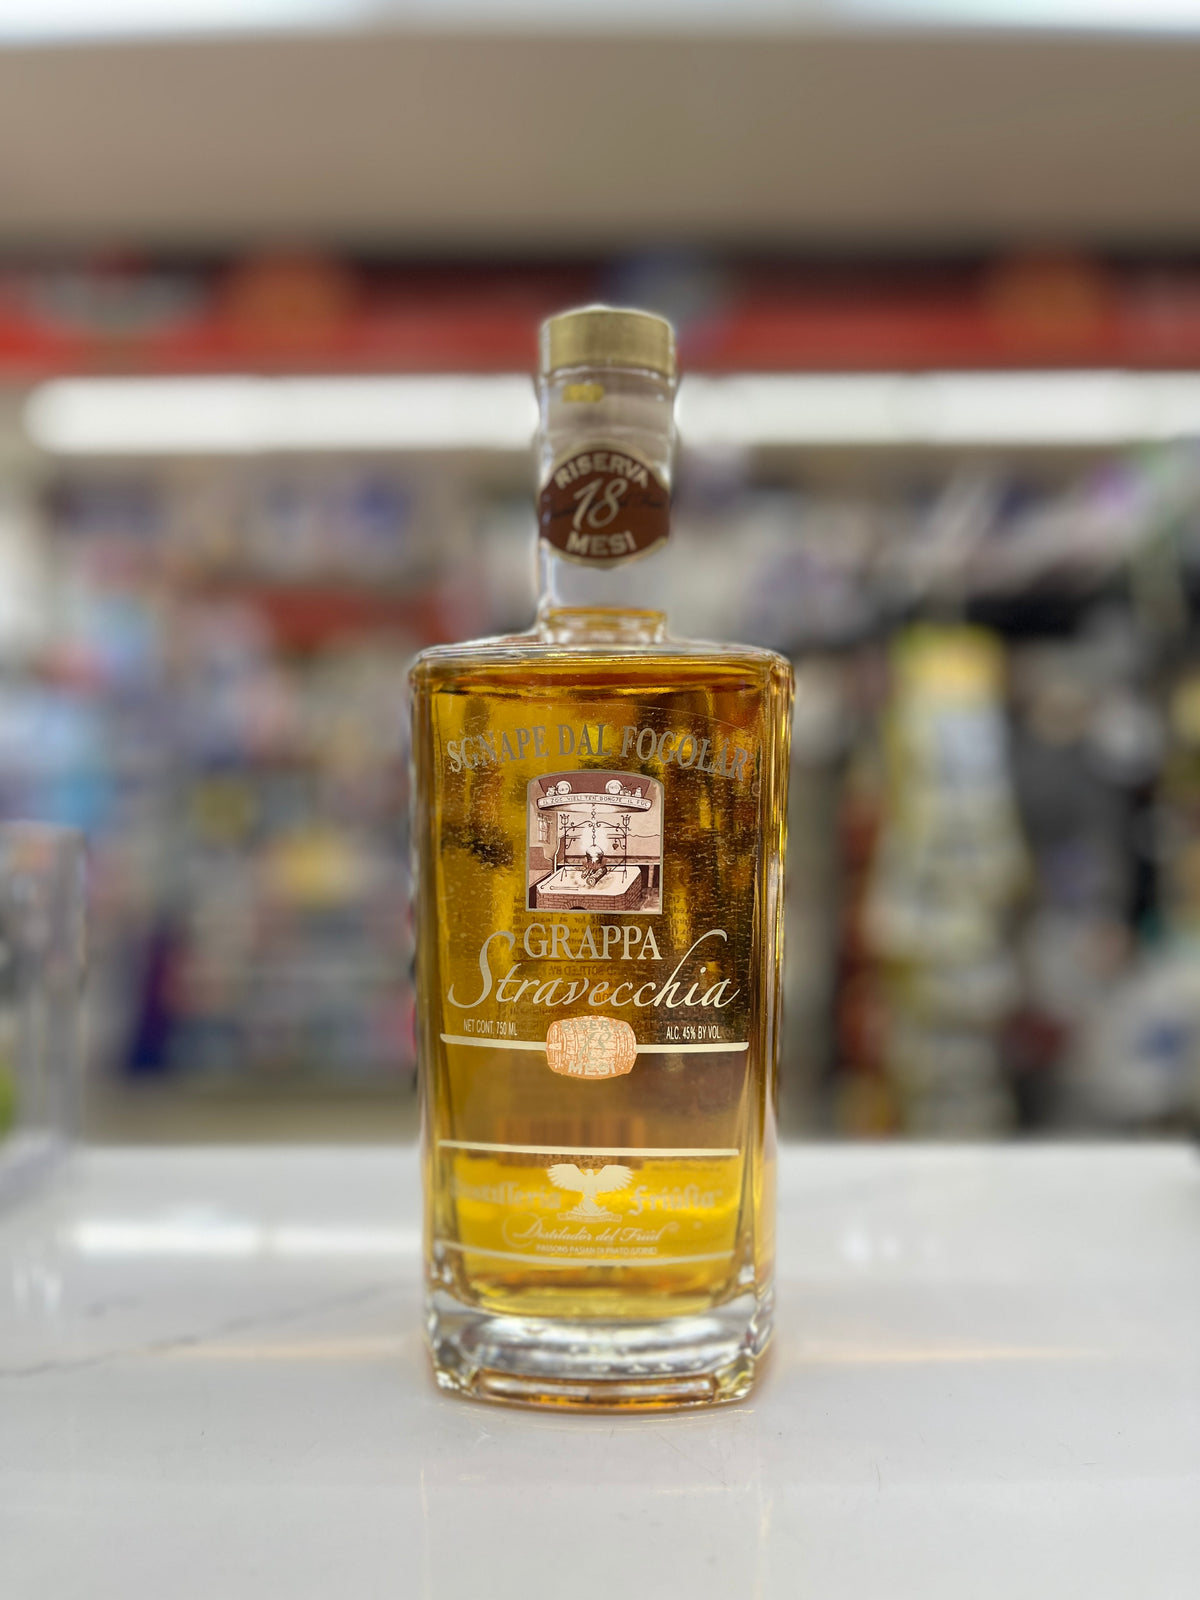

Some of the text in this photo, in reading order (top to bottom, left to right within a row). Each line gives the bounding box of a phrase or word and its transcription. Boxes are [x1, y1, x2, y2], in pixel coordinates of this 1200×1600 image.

[554, 452, 649, 489] RISERVA
[573, 478, 628, 531] 18
[565, 530, 638, 556] MESI
[446, 725, 550, 773] SGNAPE
[555, 723, 612, 757] DAL
[523, 922, 663, 960] GRAPPA
[447, 928, 741, 1009] Stravecchia
[463, 1018, 475, 1033] NET
[496, 1021, 507, 1036] 750
[508, 1021, 518, 1036] ML
[665, 1025, 681, 1040] ALC.
[682, 1025, 697, 1040] 45%
[697, 1025, 707, 1039] BY
[567, 1060, 616, 1076] MESI
